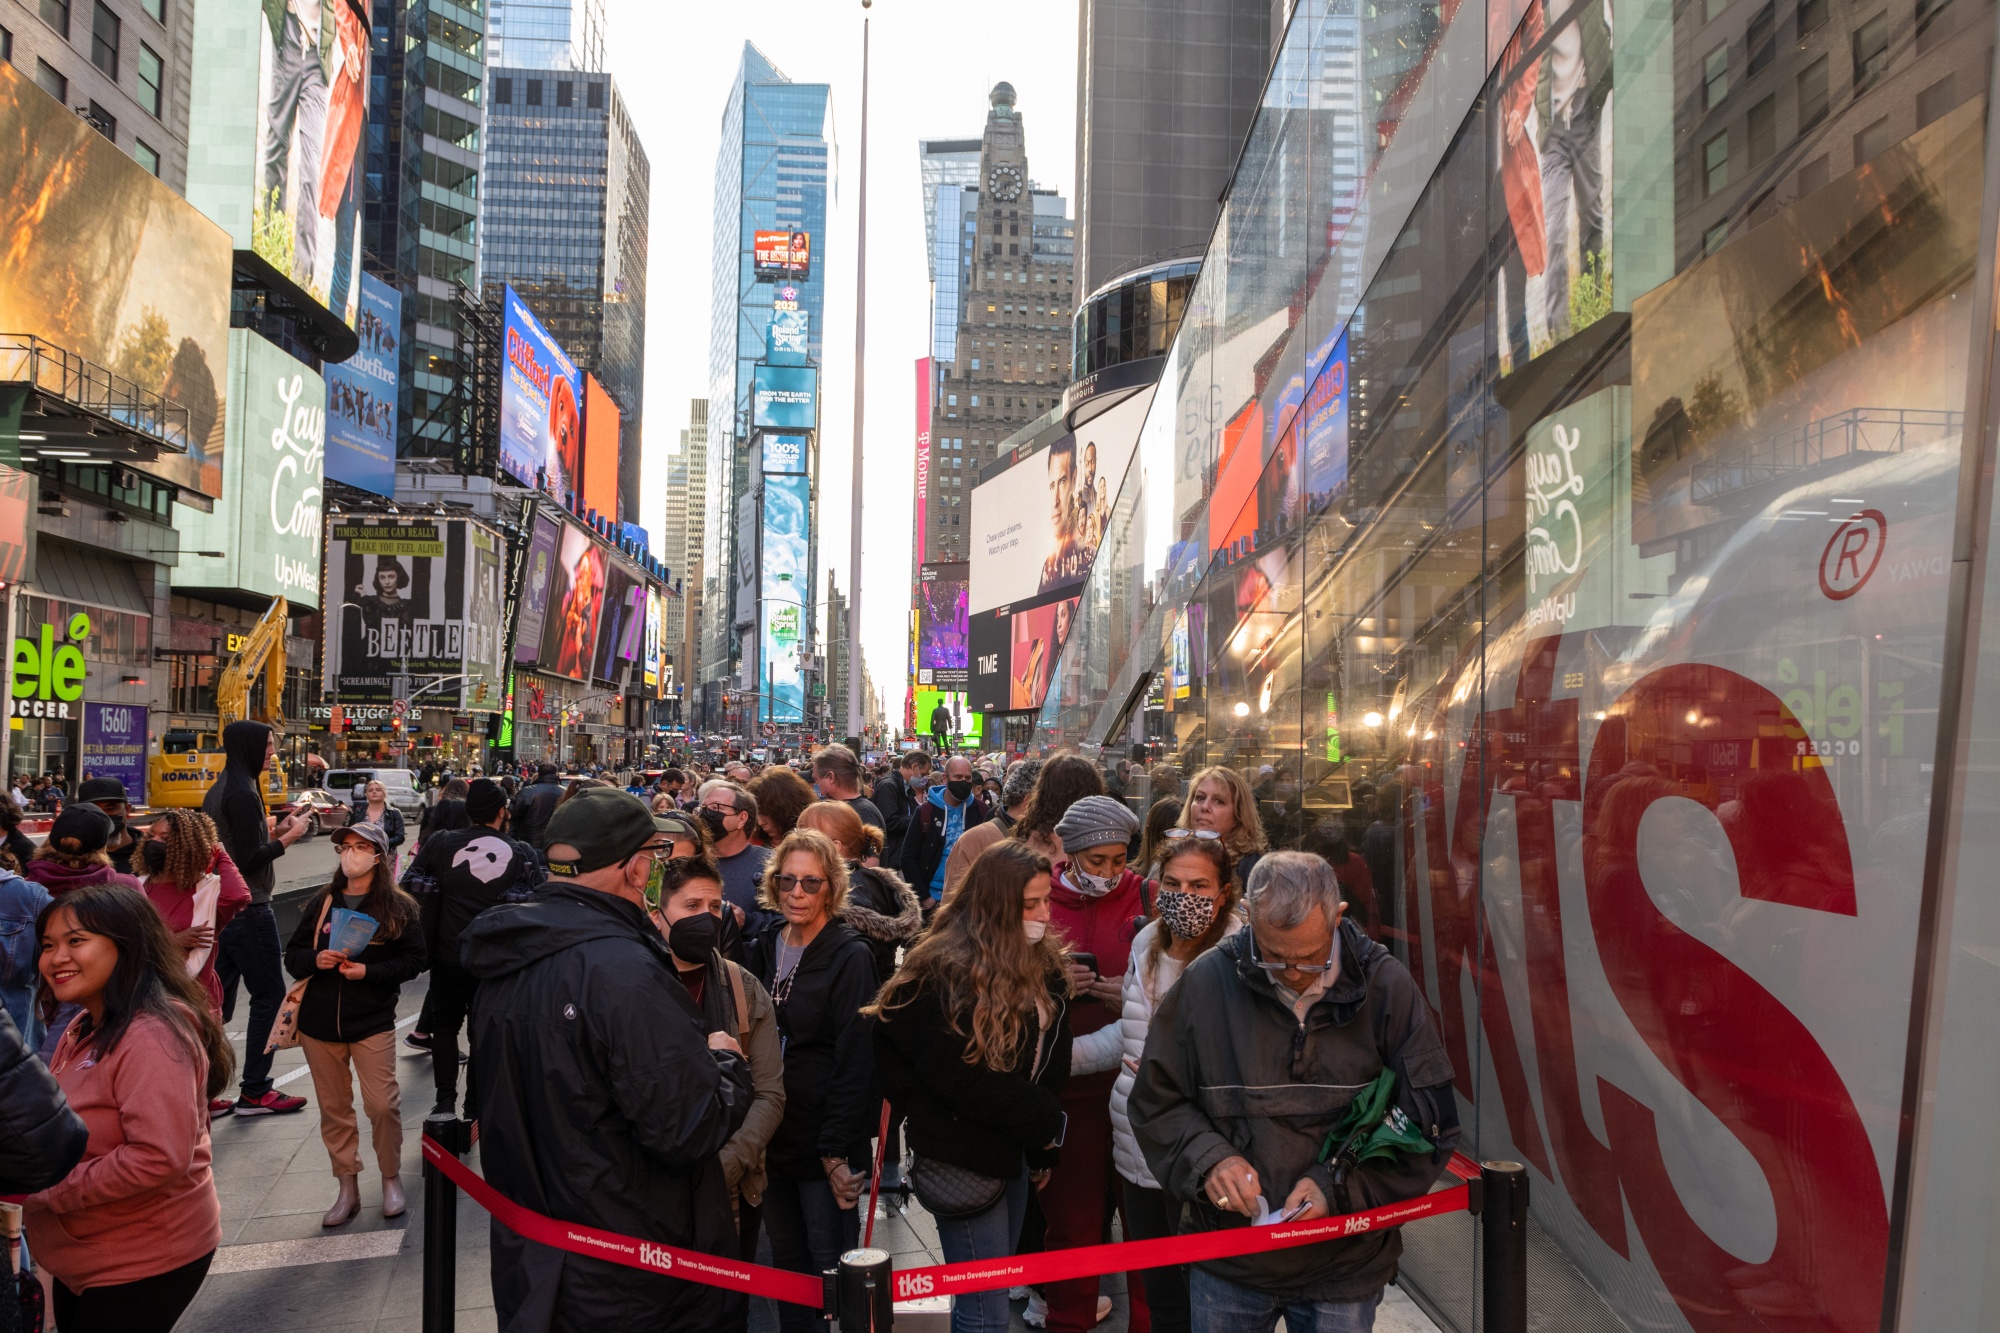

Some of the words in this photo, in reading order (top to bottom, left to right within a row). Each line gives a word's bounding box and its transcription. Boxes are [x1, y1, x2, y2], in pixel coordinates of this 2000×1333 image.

[756, 250, 769, 261] THE
[793, 251, 807, 263] LIFE
[774, 300, 798, 311] 2021
[772, 325, 799, 339] Poland
[775, 333, 801, 347] Spring
[507, 325, 550, 399] Clifford
[1070, 373, 1099, 393] MARRIOTT
[1070, 386, 1094, 402] MARQUIS
[770, 443, 800, 454] 100%
[918, 447, 930, 499] Mobile
[336, 527, 359, 538] TIMES
[360, 527, 389, 538] SQUARE
[391, 527, 406, 538] CAN
[408, 527, 436, 538] REALLY
[986, 533, 997, 544] Chase
[997, 529, 1006, 541] your
[355, 541, 377, 552] MAKE
[379, 542, 394, 552] YOU
[396, 542, 415, 553] FEEL
[417, 543, 443, 554] ALIVE!
[989, 544, 1001, 556] Watch
[1000, 541, 1010, 554] your
[772, 613, 795, 625] Poland
[774, 621, 797, 632] Spring
[978, 653, 998, 675] TIME
[100, 706, 128, 733] 1560
[83, 755, 103, 766] SPACE
[104, 755, 135, 766] AVAILABLE
[1270, 1230, 1291, 1240] Theatre
[1291, 1227, 1325, 1238] Development
[1325, 1225, 1338, 1233] Fund
[1344, 1216, 1370, 1234] tkts
[1376, 1214, 1393, 1222] Theatre
[1393, 1206, 1420, 1219] Development
[1420, 1202, 1432, 1212] Fund
[567, 1231, 586, 1243] Theatre
[586, 1236, 620, 1252] Development
[620, 1244, 634, 1254] Fund
[639, 1243, 672, 1269] tkts
[677, 1257, 697, 1269] Theatre
[698, 1262, 735, 1278] Development
[735, 1271, 750, 1281] Fund
[898, 1273, 934, 1298] tkts
[942, 1273, 966, 1283] Theatre
[966, 1268, 1007, 1280] Development
[1007, 1265, 1024, 1275] Fund
